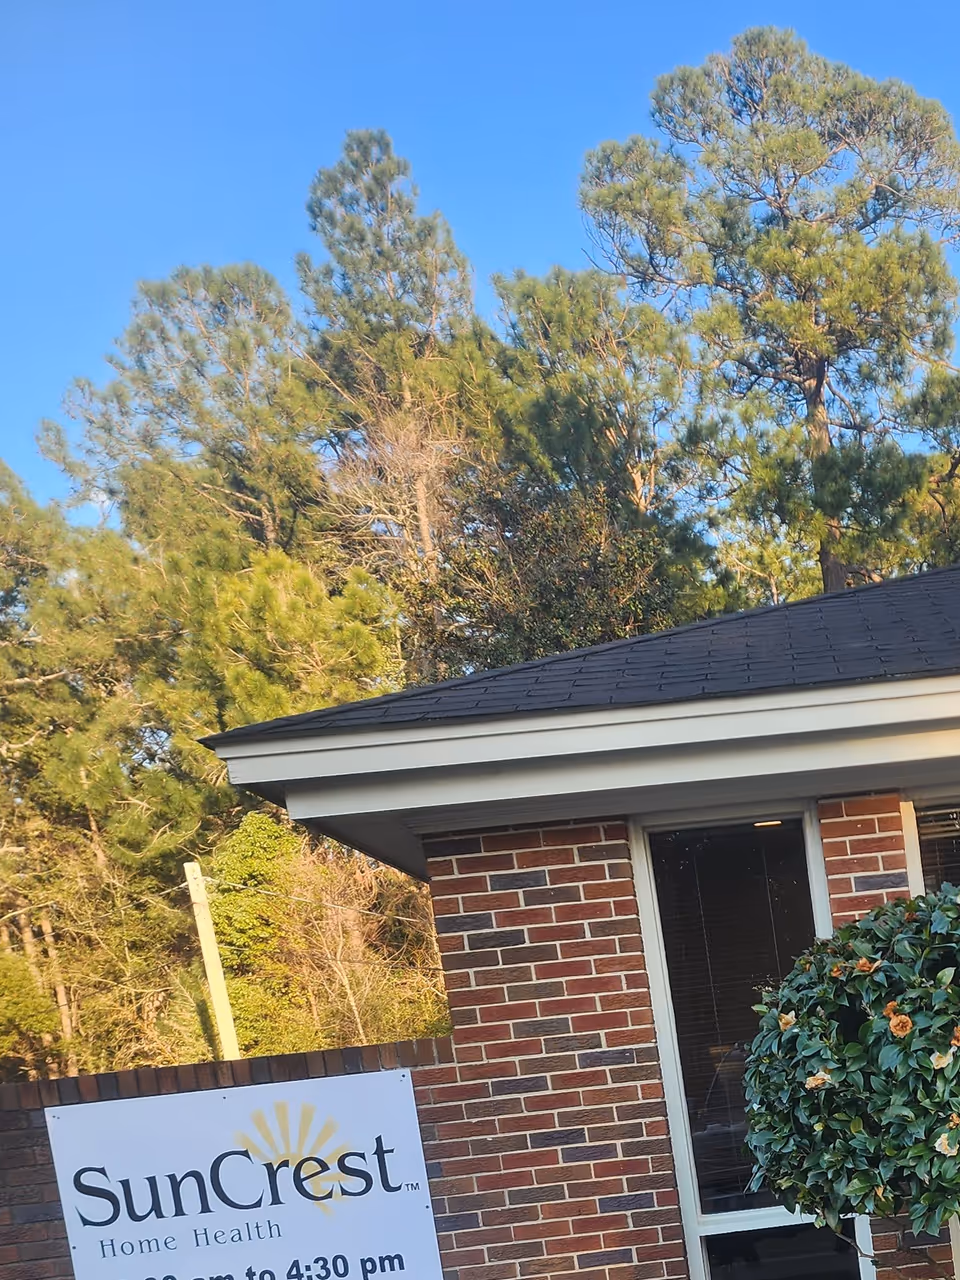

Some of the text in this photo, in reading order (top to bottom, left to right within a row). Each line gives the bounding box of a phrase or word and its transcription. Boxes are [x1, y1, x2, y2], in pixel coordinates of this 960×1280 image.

[73, 1134, 403, 1228] SunCrest
[99, 1220, 283, 1259] Home Health
[360, 1252, 405, 1280] pm
